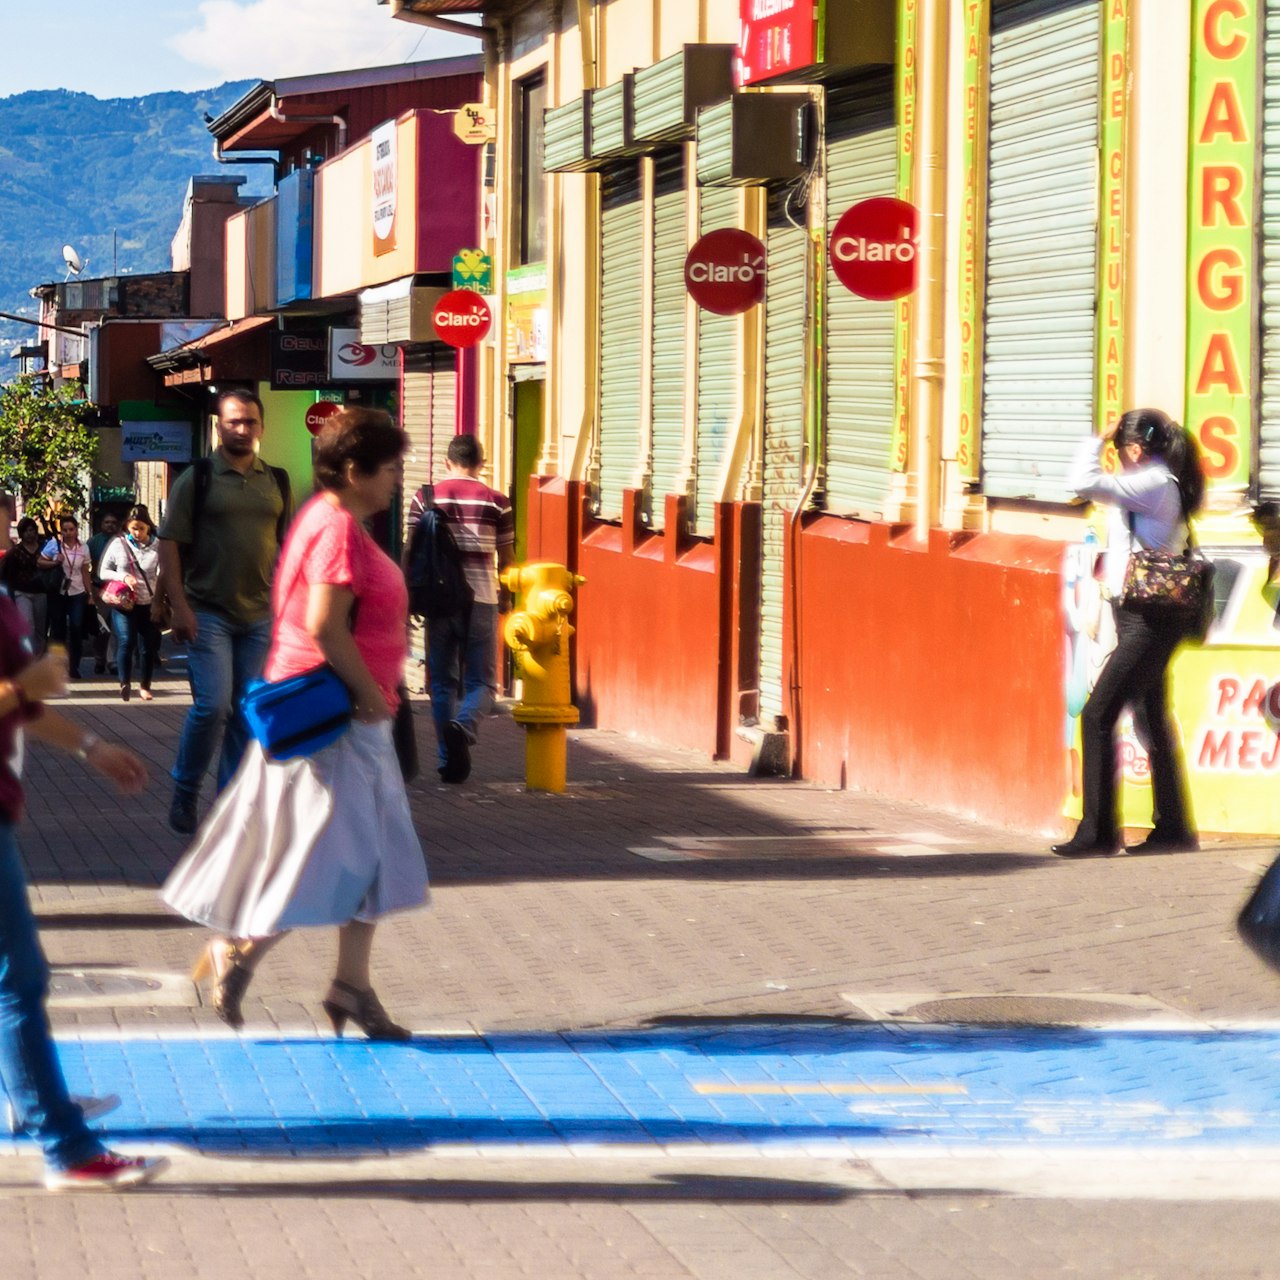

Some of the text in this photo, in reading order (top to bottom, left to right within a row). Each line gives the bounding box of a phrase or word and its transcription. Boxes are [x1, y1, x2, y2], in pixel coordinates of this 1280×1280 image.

[1111, 53, 1124, 118] DE
[835, 237, 915, 262] Claro
[690, 263, 754, 282] Claro
[435, 312, 480, 326] Claro
[307, 415, 330, 424] Clar
